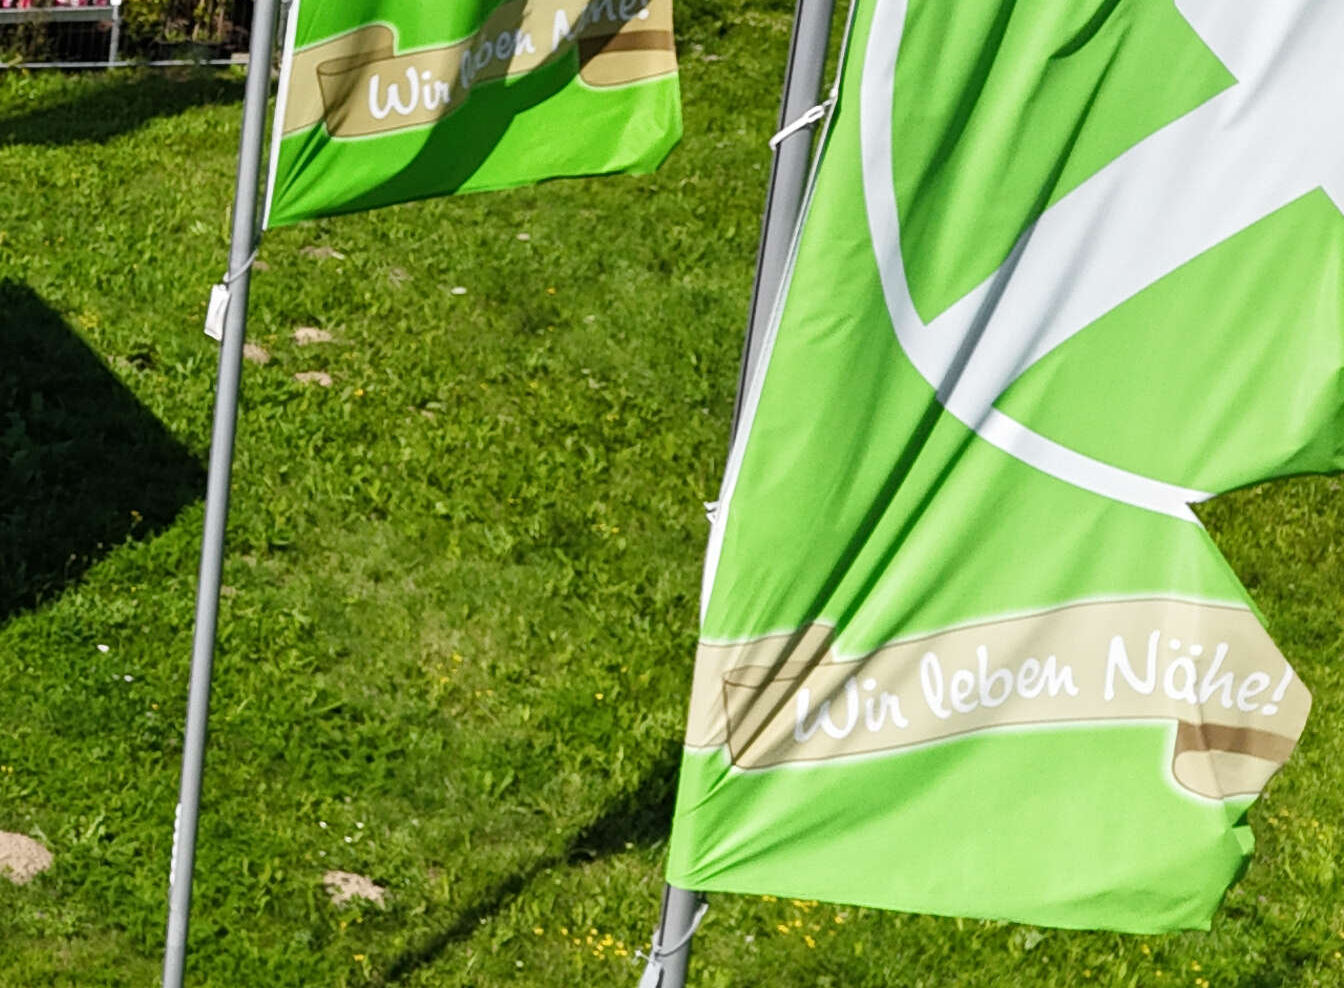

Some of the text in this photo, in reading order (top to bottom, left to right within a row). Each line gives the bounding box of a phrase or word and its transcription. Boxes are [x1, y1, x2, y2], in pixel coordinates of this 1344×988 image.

[368, 66, 451, 120] Wir
[794, 629, 1294, 743] Wir leben Nähe!
